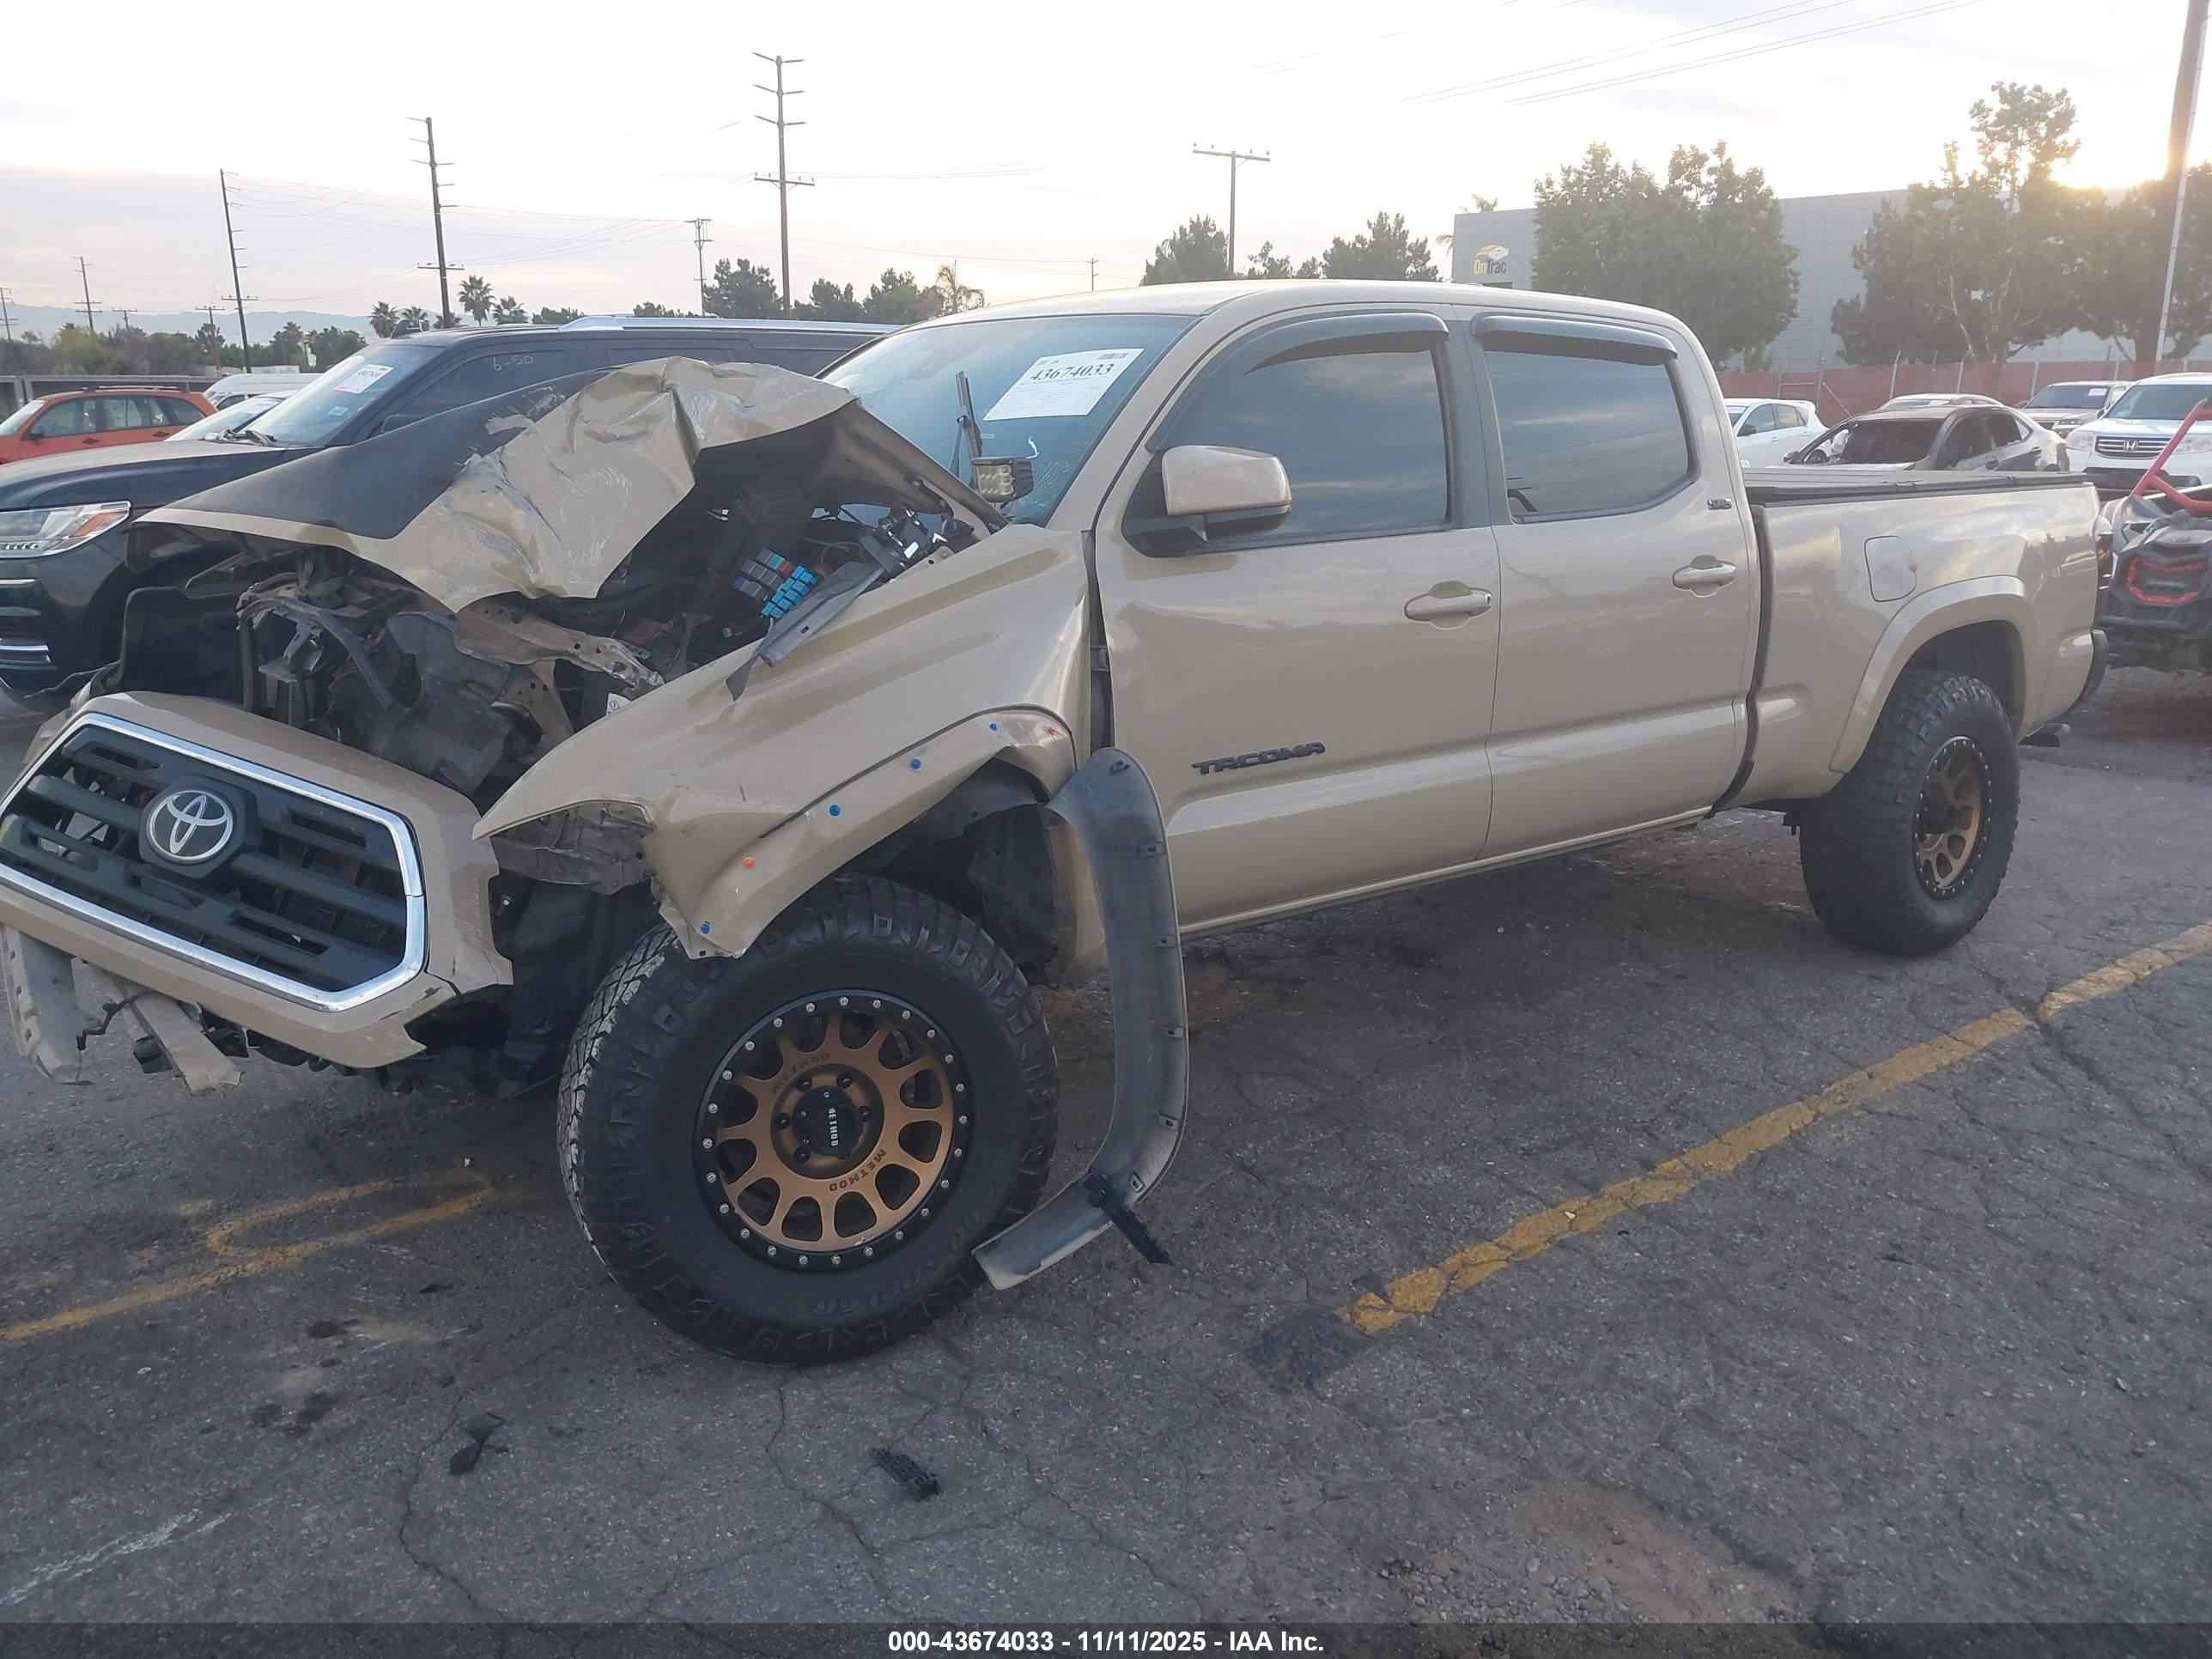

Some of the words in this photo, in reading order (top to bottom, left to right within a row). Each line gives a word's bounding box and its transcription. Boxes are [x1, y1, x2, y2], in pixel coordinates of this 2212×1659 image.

[1474, 258, 1507, 275] OnTrac
[1030, 363, 1115, 380] 43674033
[1191, 741, 1326, 775] TACOMA
[827, 1106, 840, 1147] METHOD
[829, 1148, 888, 1192] METHOD
